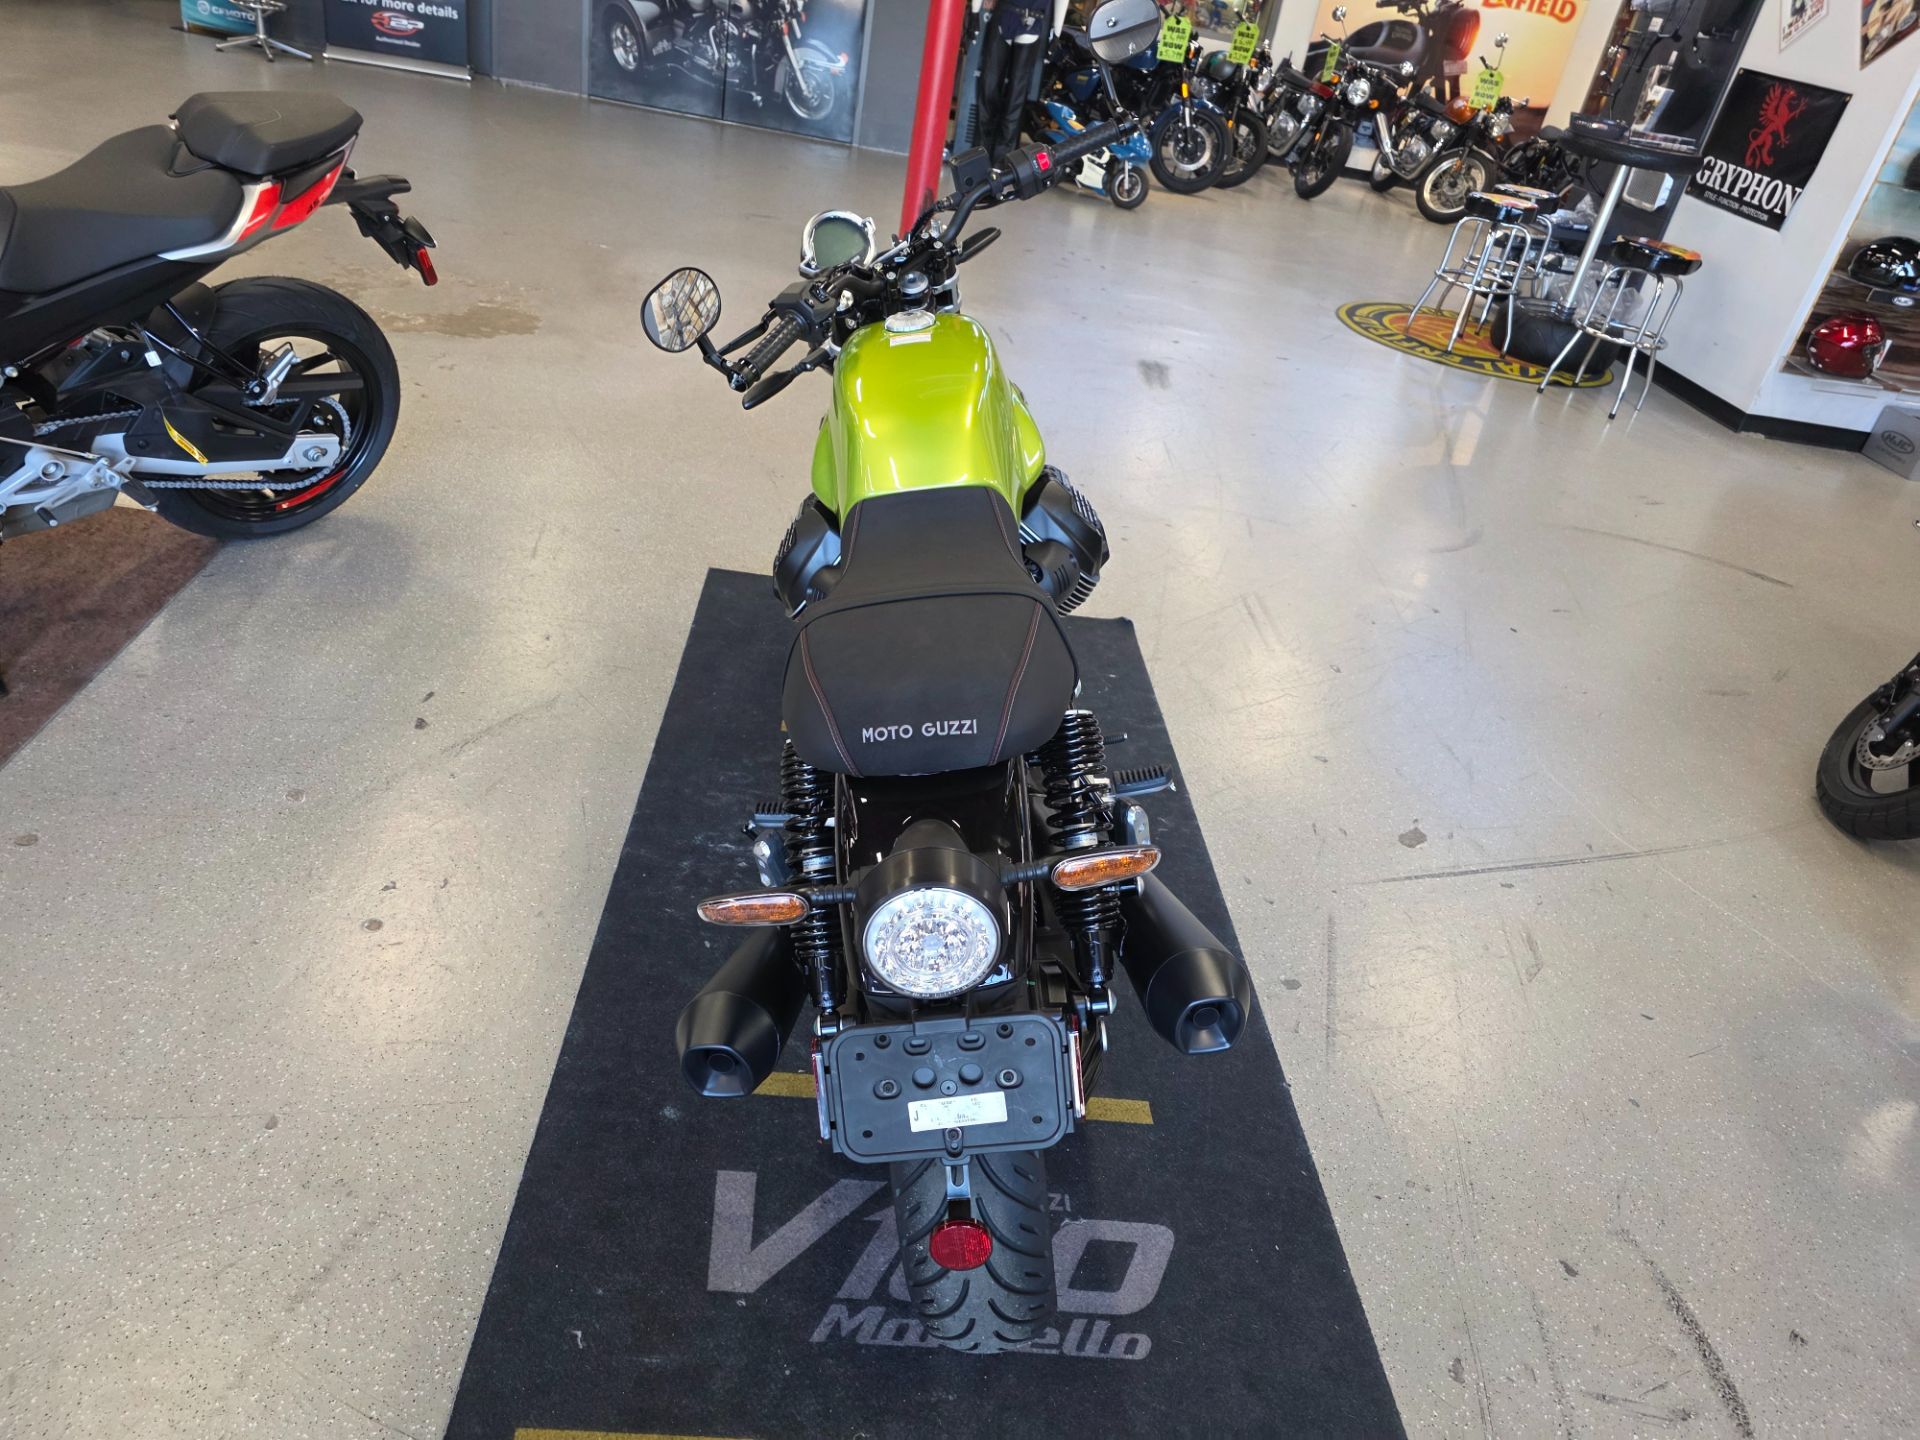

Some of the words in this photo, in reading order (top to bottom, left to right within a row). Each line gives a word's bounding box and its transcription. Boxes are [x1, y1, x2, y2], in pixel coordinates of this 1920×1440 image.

[382, 0, 414, 12] more
[417, 3, 458, 19] details
[1167, 25, 1186, 34] WAS
[1238, 31, 1255, 39] WAS
[1163, 42, 1183, 50] NOW
[1696, 156, 1802, 216] GRYPHON
[862, 725, 913, 743] MOTO
[922, 719, 977, 736] GUZZI
[707, 1169, 1175, 1315] V10
[809, 1303, 1152, 1360] Maello
